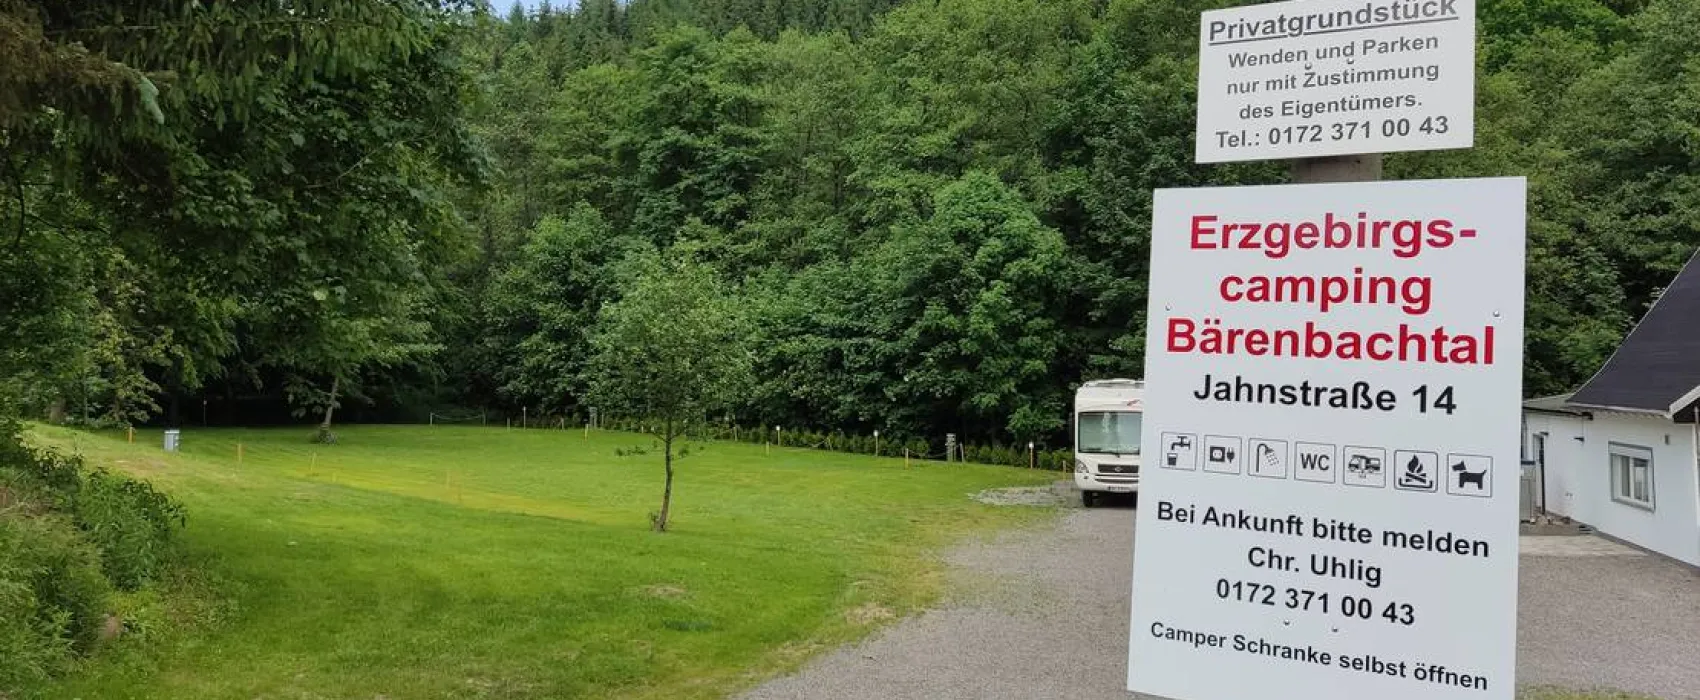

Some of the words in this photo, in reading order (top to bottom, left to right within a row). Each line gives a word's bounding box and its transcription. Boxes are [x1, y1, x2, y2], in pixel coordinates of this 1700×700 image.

[1210, 0, 1457, 42] Privatgrundstück
[1229, 48, 1308, 68] Wenden
[1316, 42, 1354, 60] und
[1363, 35, 1438, 55] Parken
[1228, 79, 1259, 94] nur
[1266, 74, 1296, 90] mit
[1304, 64, 1439, 87] Zustimmung
[1240, 101, 1273, 120] des
[1281, 93, 1422, 118] Eigentümers.
[1216, 131, 1260, 148] Tel.:
[1269, 125, 1322, 144] 0172
[1331, 121, 1370, 140] 371
[1382, 118, 1410, 136] 00
[1420, 116, 1448, 134] 43
[1190, 213, 1477, 259] Erzgebirgs-
[1220, 267, 1431, 314] camping
[1167, 318, 1495, 365] Bärenbachtal
[1194, 374, 1396, 411] Jahnstraße
[1413, 385, 1456, 414] 14
[1301, 453, 1329, 471] WC
[1158, 502, 1195, 524] Bei
[1202, 507, 1303, 536] Ankunft
[1313, 518, 1372, 544] bitte
[1383, 529, 1489, 557] melden
[1248, 548, 1299, 572] Chr.
[1311, 554, 1382, 587] Uhlig
[1216, 579, 1275, 605] 0172
[1285, 589, 1329, 614] 371
[1341, 597, 1371, 619] 00
[1382, 602, 1414, 625] 43
[1151, 622, 1227, 648] Camper
[1233, 634, 1332, 665] Schranke
[1339, 654, 1406, 678] selbst
[1414, 664, 1488, 690] öffnen
